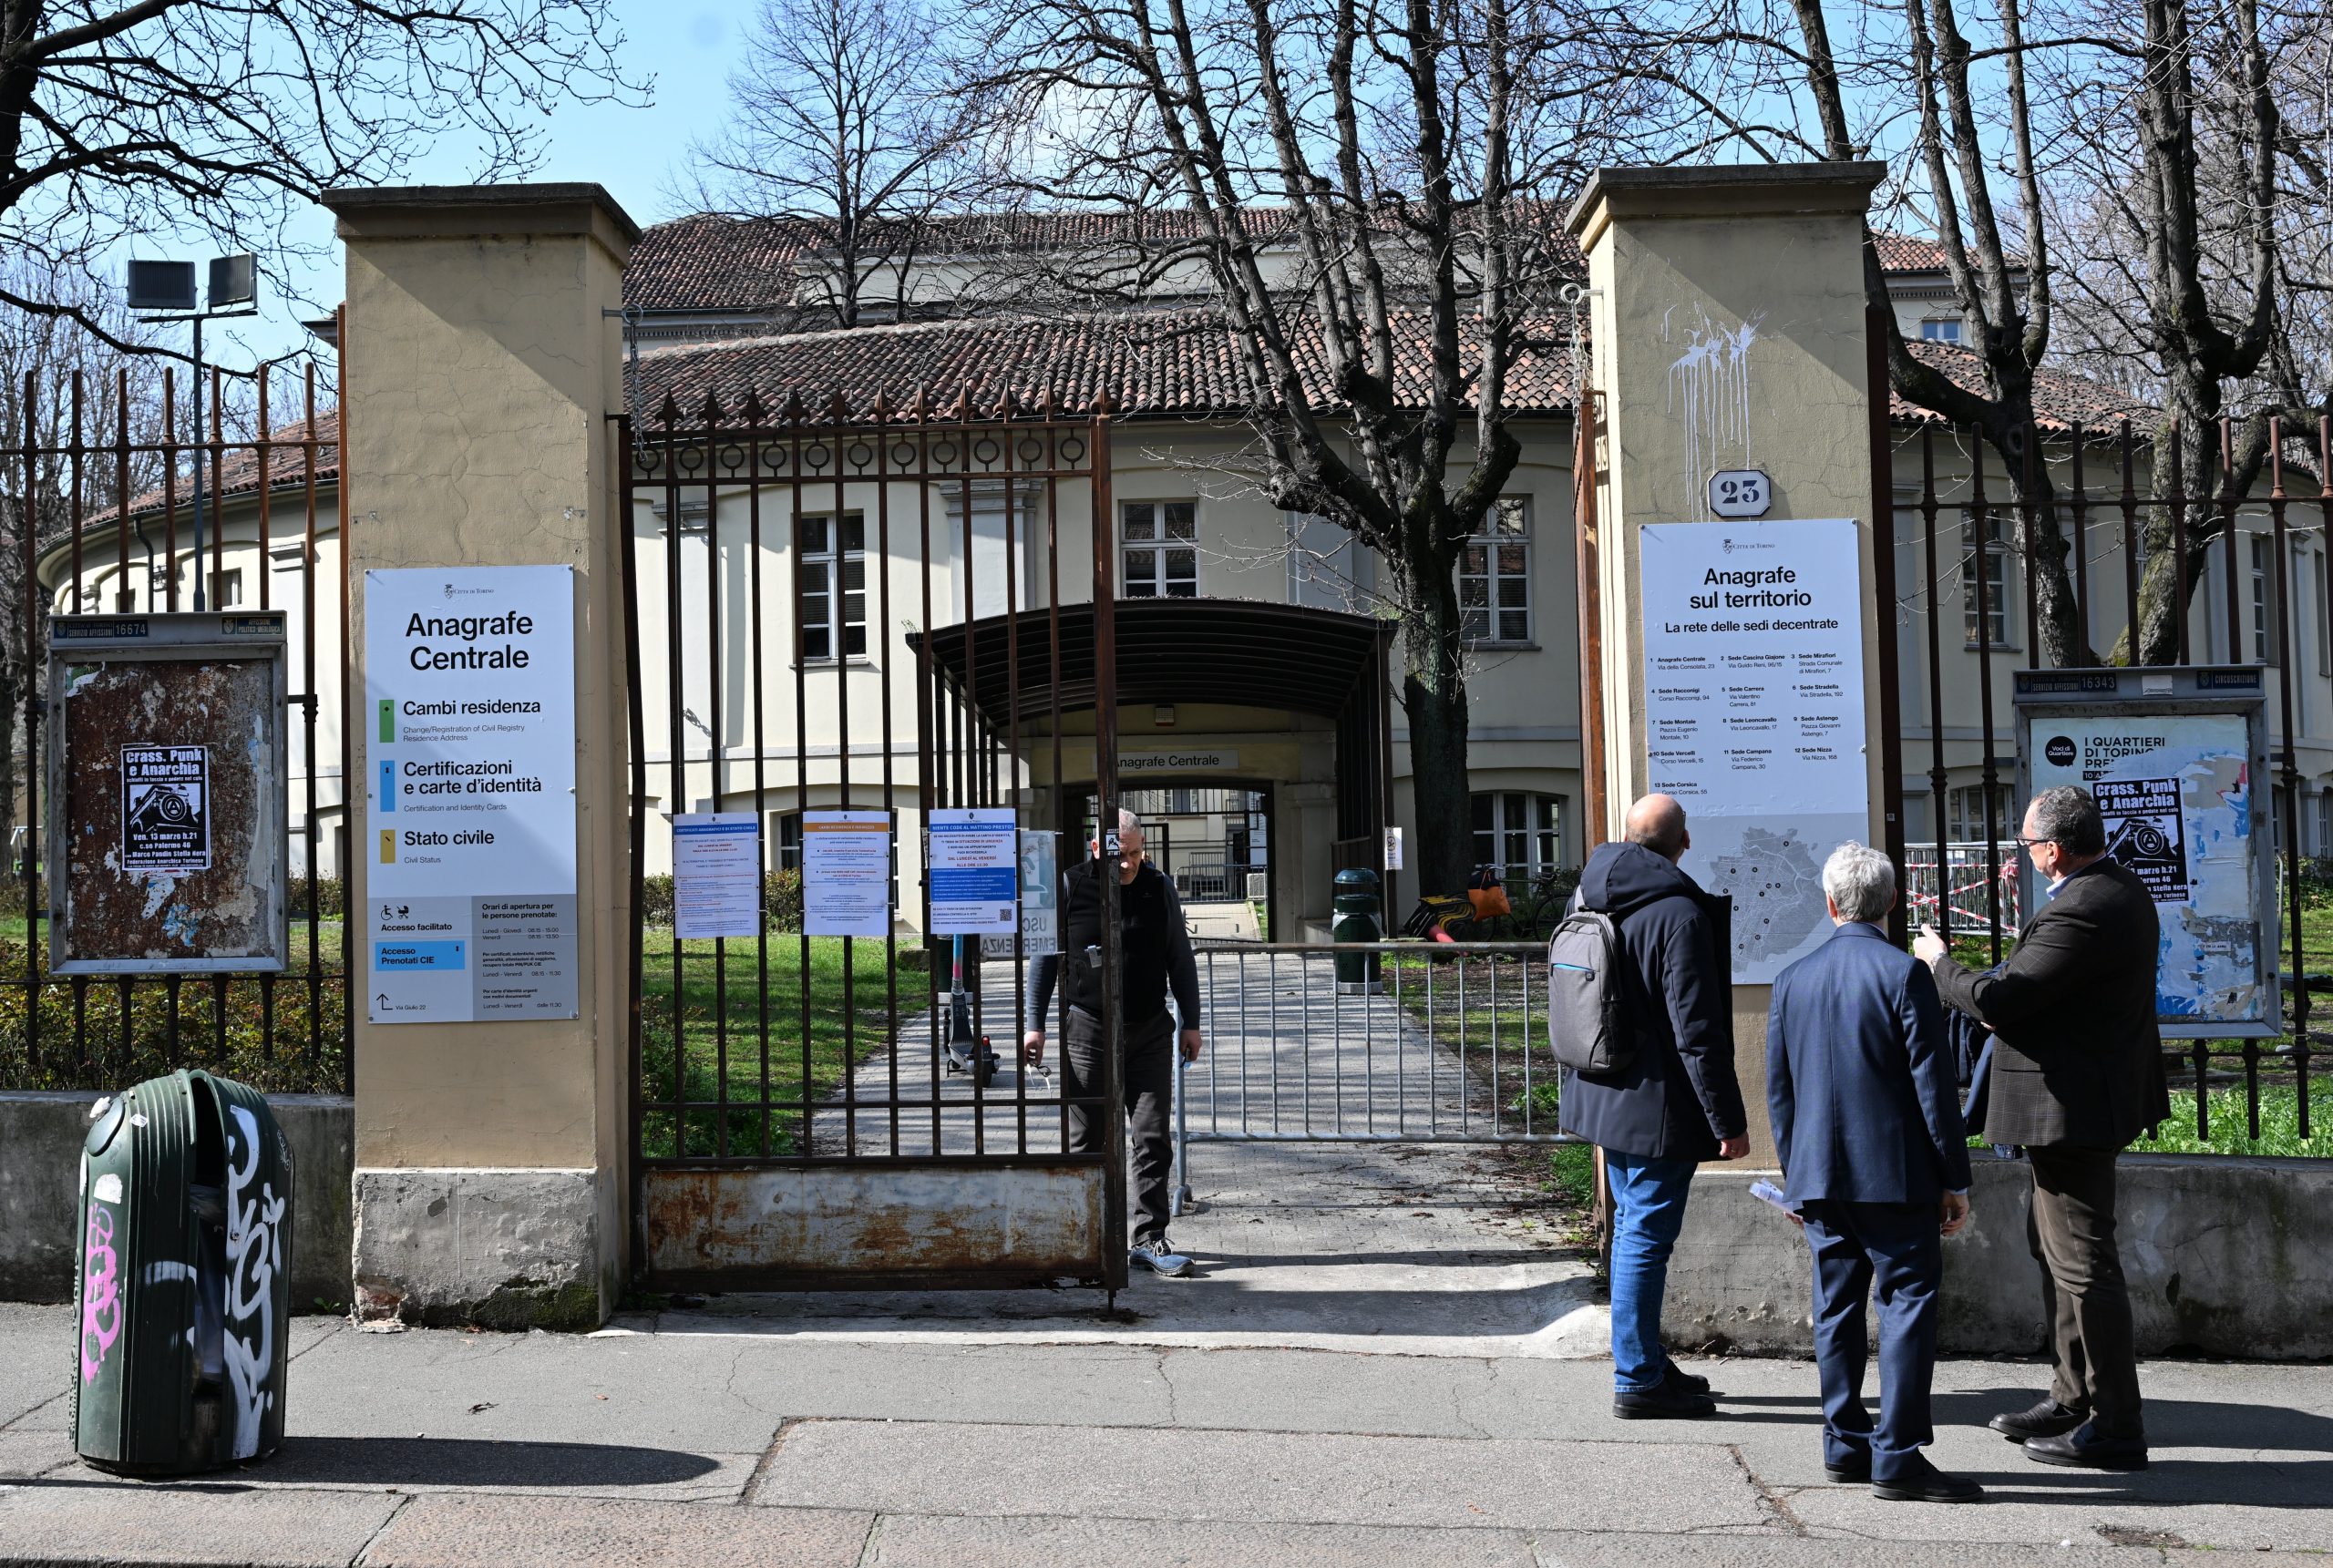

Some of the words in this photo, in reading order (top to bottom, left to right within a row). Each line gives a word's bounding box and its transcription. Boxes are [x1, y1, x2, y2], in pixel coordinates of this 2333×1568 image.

[1721, 480, 1760, 503] 23
[1704, 567, 1795, 588] Anagrafe
[1691, 591, 1718, 609] sul
[1725, 589, 1811, 608] territorio
[116, 624, 146, 634] 16674
[406, 610, 533, 641] Anagrafe
[1666, 622, 1680, 633] La
[1683, 621, 1707, 632] rete
[1711, 620, 1740, 631] delle
[1743, 620, 1768, 630] sedi
[1773, 619, 1838, 630] decentrate
[410, 644, 529, 671] Centrale
[2082, 677, 2114, 688] 16343
[2215, 675, 2256, 683] CIRCOSCRIZIONE
[404, 701, 456, 715] Cambi
[462, 700, 540, 713] residenza
[404, 725, 471, 733] Change/Registration
[2085, 737, 2088, 746] I
[2093, 737, 2164, 747] QUARTIERI
[170, 749, 201, 762] Punk
[2085, 749, 2098, 757] DI
[1169, 755, 1219, 766] Centrale
[129, 765, 137, 775] e
[141, 763, 200, 775] Anarchia
[404, 760, 512, 776] Certificazioni
[405, 784, 414, 794] e
[419, 781, 461, 794] carte
[2143, 779, 2176, 793] Punk
[460, 804, 485, 812] Identity
[2101, 800, 2108, 810] e
[2113, 794, 2174, 809] Anarchia
[405, 831, 447, 845] Stato
[453, 830, 494, 845] civile
